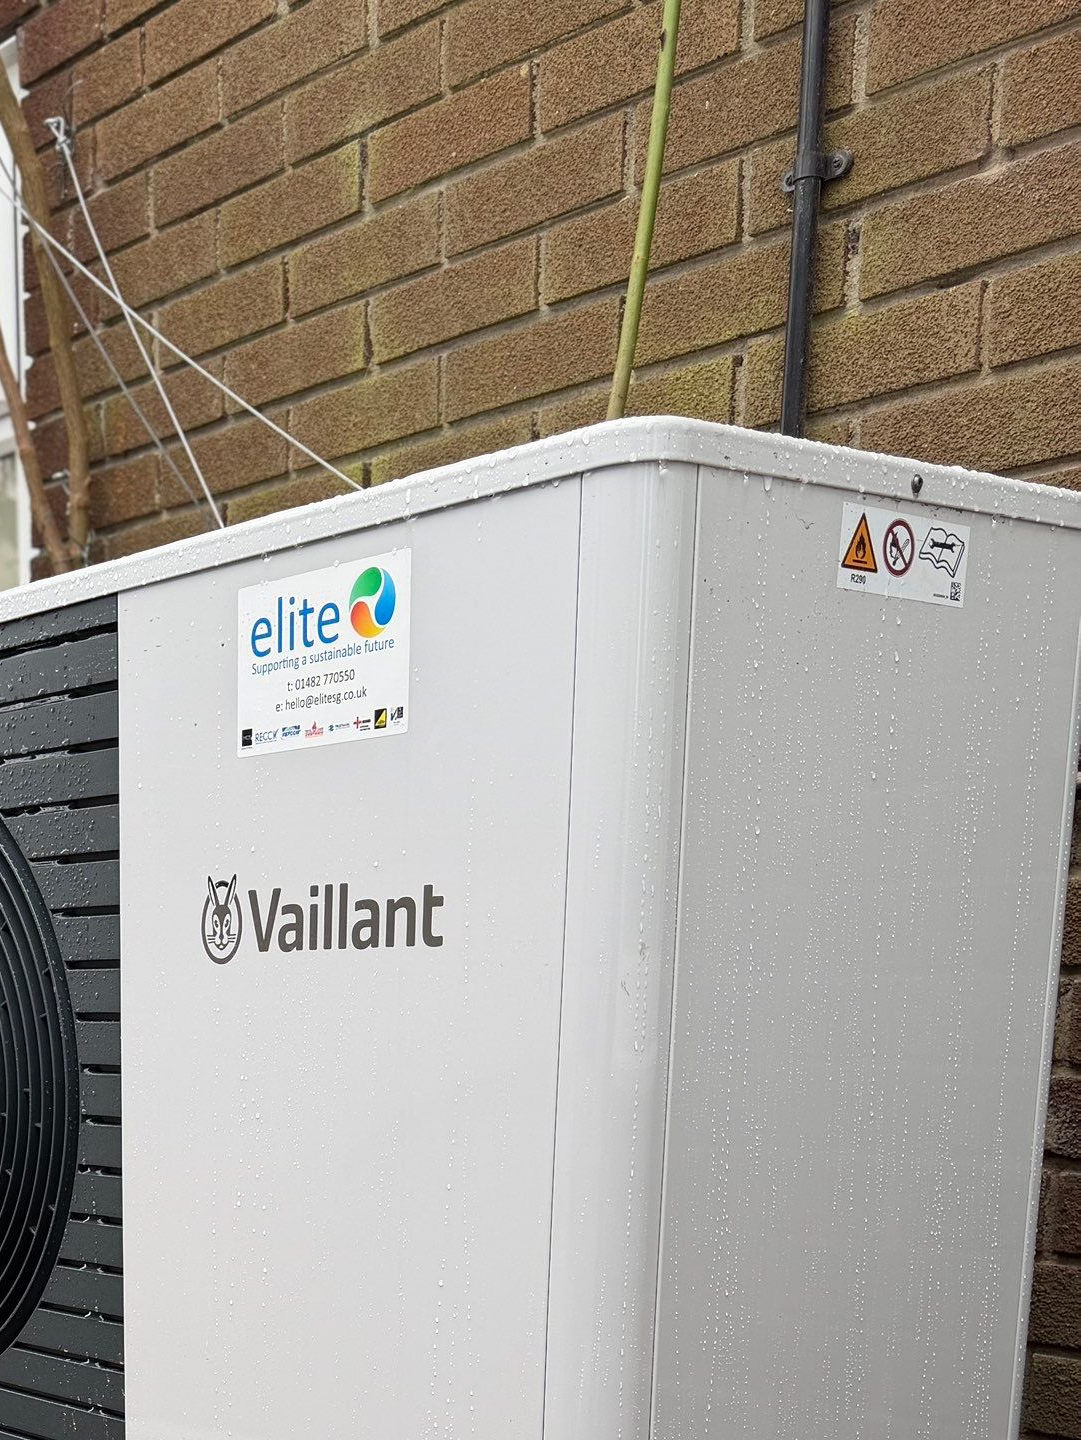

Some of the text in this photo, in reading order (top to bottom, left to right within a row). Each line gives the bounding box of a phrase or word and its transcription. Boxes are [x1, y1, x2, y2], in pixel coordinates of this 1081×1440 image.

[850, 573, 867, 585] R290
[250, 596, 340, 658] elite
[251, 637, 395, 676] Supporting a sustainable future
[287, 669, 356, 692] t: 01482 770550
[275, 686, 367, 712] e: hello@elitesg.co.uk
[248, 883, 444, 953] Vaillant
